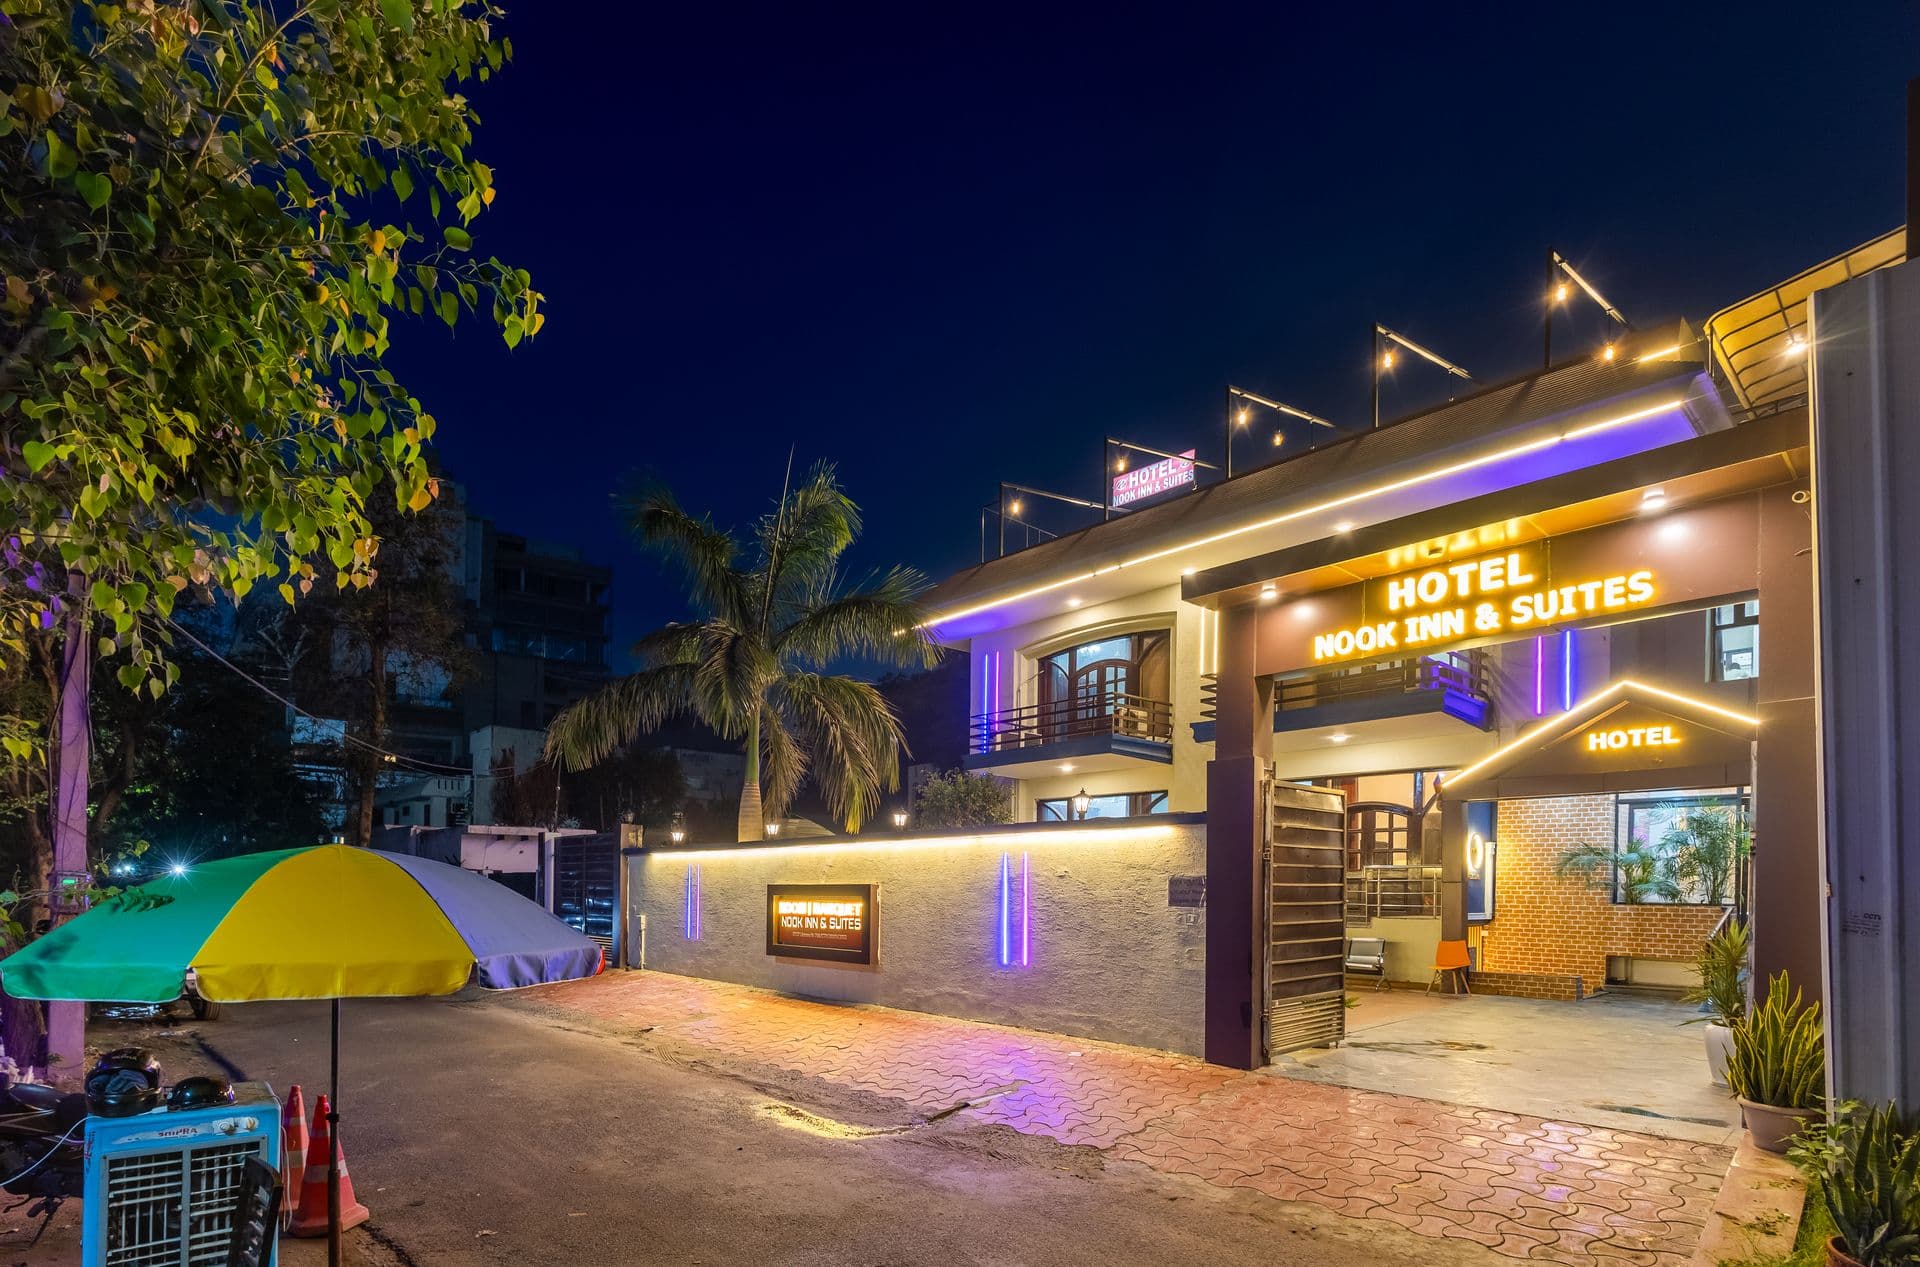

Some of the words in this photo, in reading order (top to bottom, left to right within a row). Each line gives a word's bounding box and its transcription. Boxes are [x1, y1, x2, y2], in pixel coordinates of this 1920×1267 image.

[1113, 490, 1136, 507] NOOK
[1138, 485, 1152, 499] INN
[1154, 483, 1161, 493] &
[1163, 470, 1194, 489] SUITES
[1129, 459, 1177, 488] HOTEL
[1388, 554, 1533, 610] HOTEL
[1314, 622, 1397, 660] NOOK
[1405, 608, 1464, 643] INN
[1475, 603, 1499, 630] &
[1511, 571, 1654, 625] SUITES
[1588, 726, 1680, 751] HOTEL
[781, 916, 803, 928] NOOK
[805, 917, 818, 929] INN
[820, 917, 827, 929] &
[829, 918, 861, 930] SUITES
